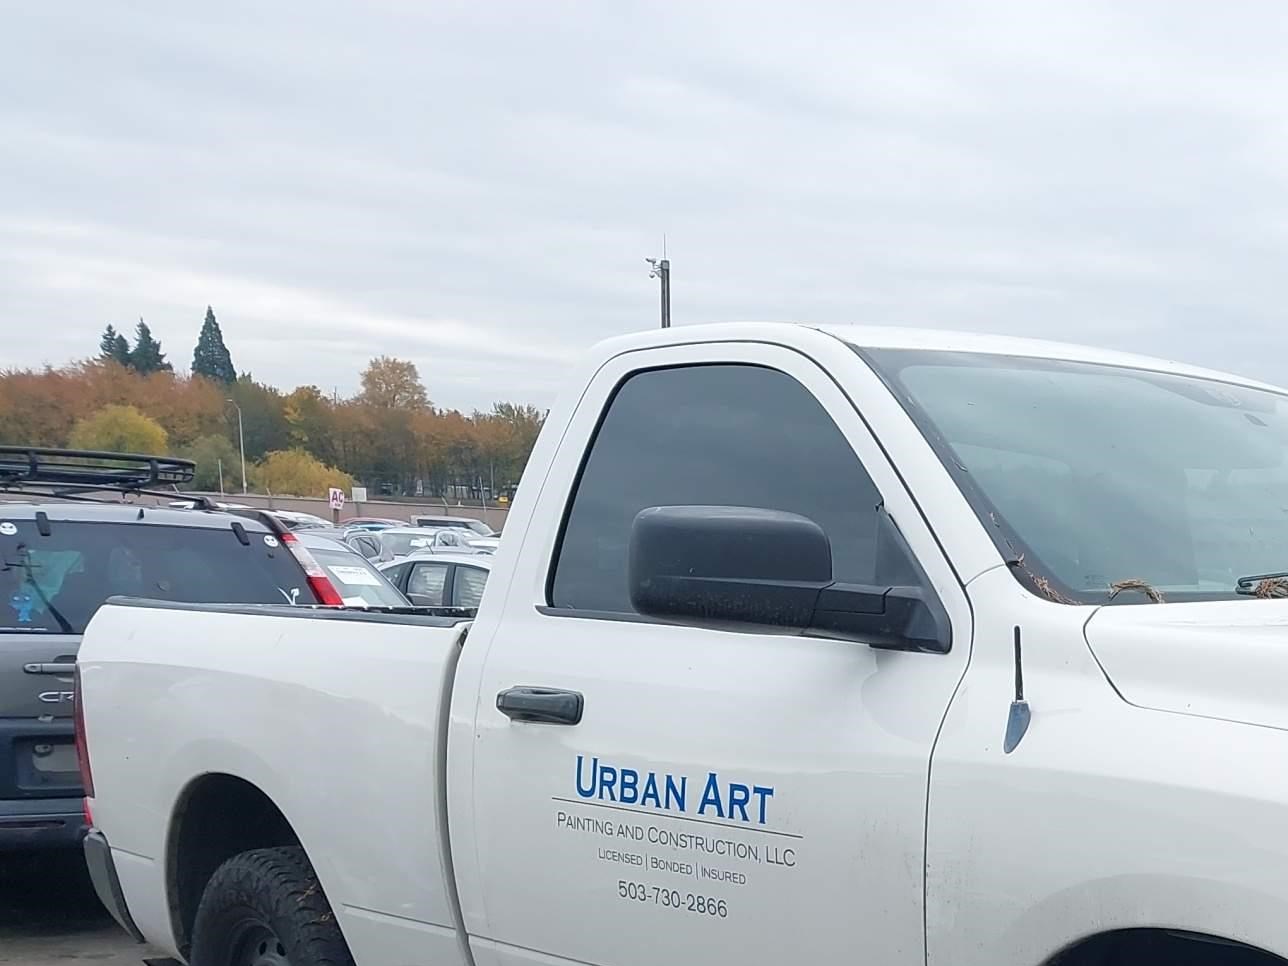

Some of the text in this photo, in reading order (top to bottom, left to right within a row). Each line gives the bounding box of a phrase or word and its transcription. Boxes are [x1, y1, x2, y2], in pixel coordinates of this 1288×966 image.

[576, 755, 774, 825] URBAN ART
[557, 811, 796, 867] PAINTING AND CONSTRUCTION, LLC
[598, 848, 642, 866] LICENSED
[650, 857, 693, 875] BONDED
[701, 865, 746, 885] INSURED
[618, 880, 728, 918] 503-730-2866
